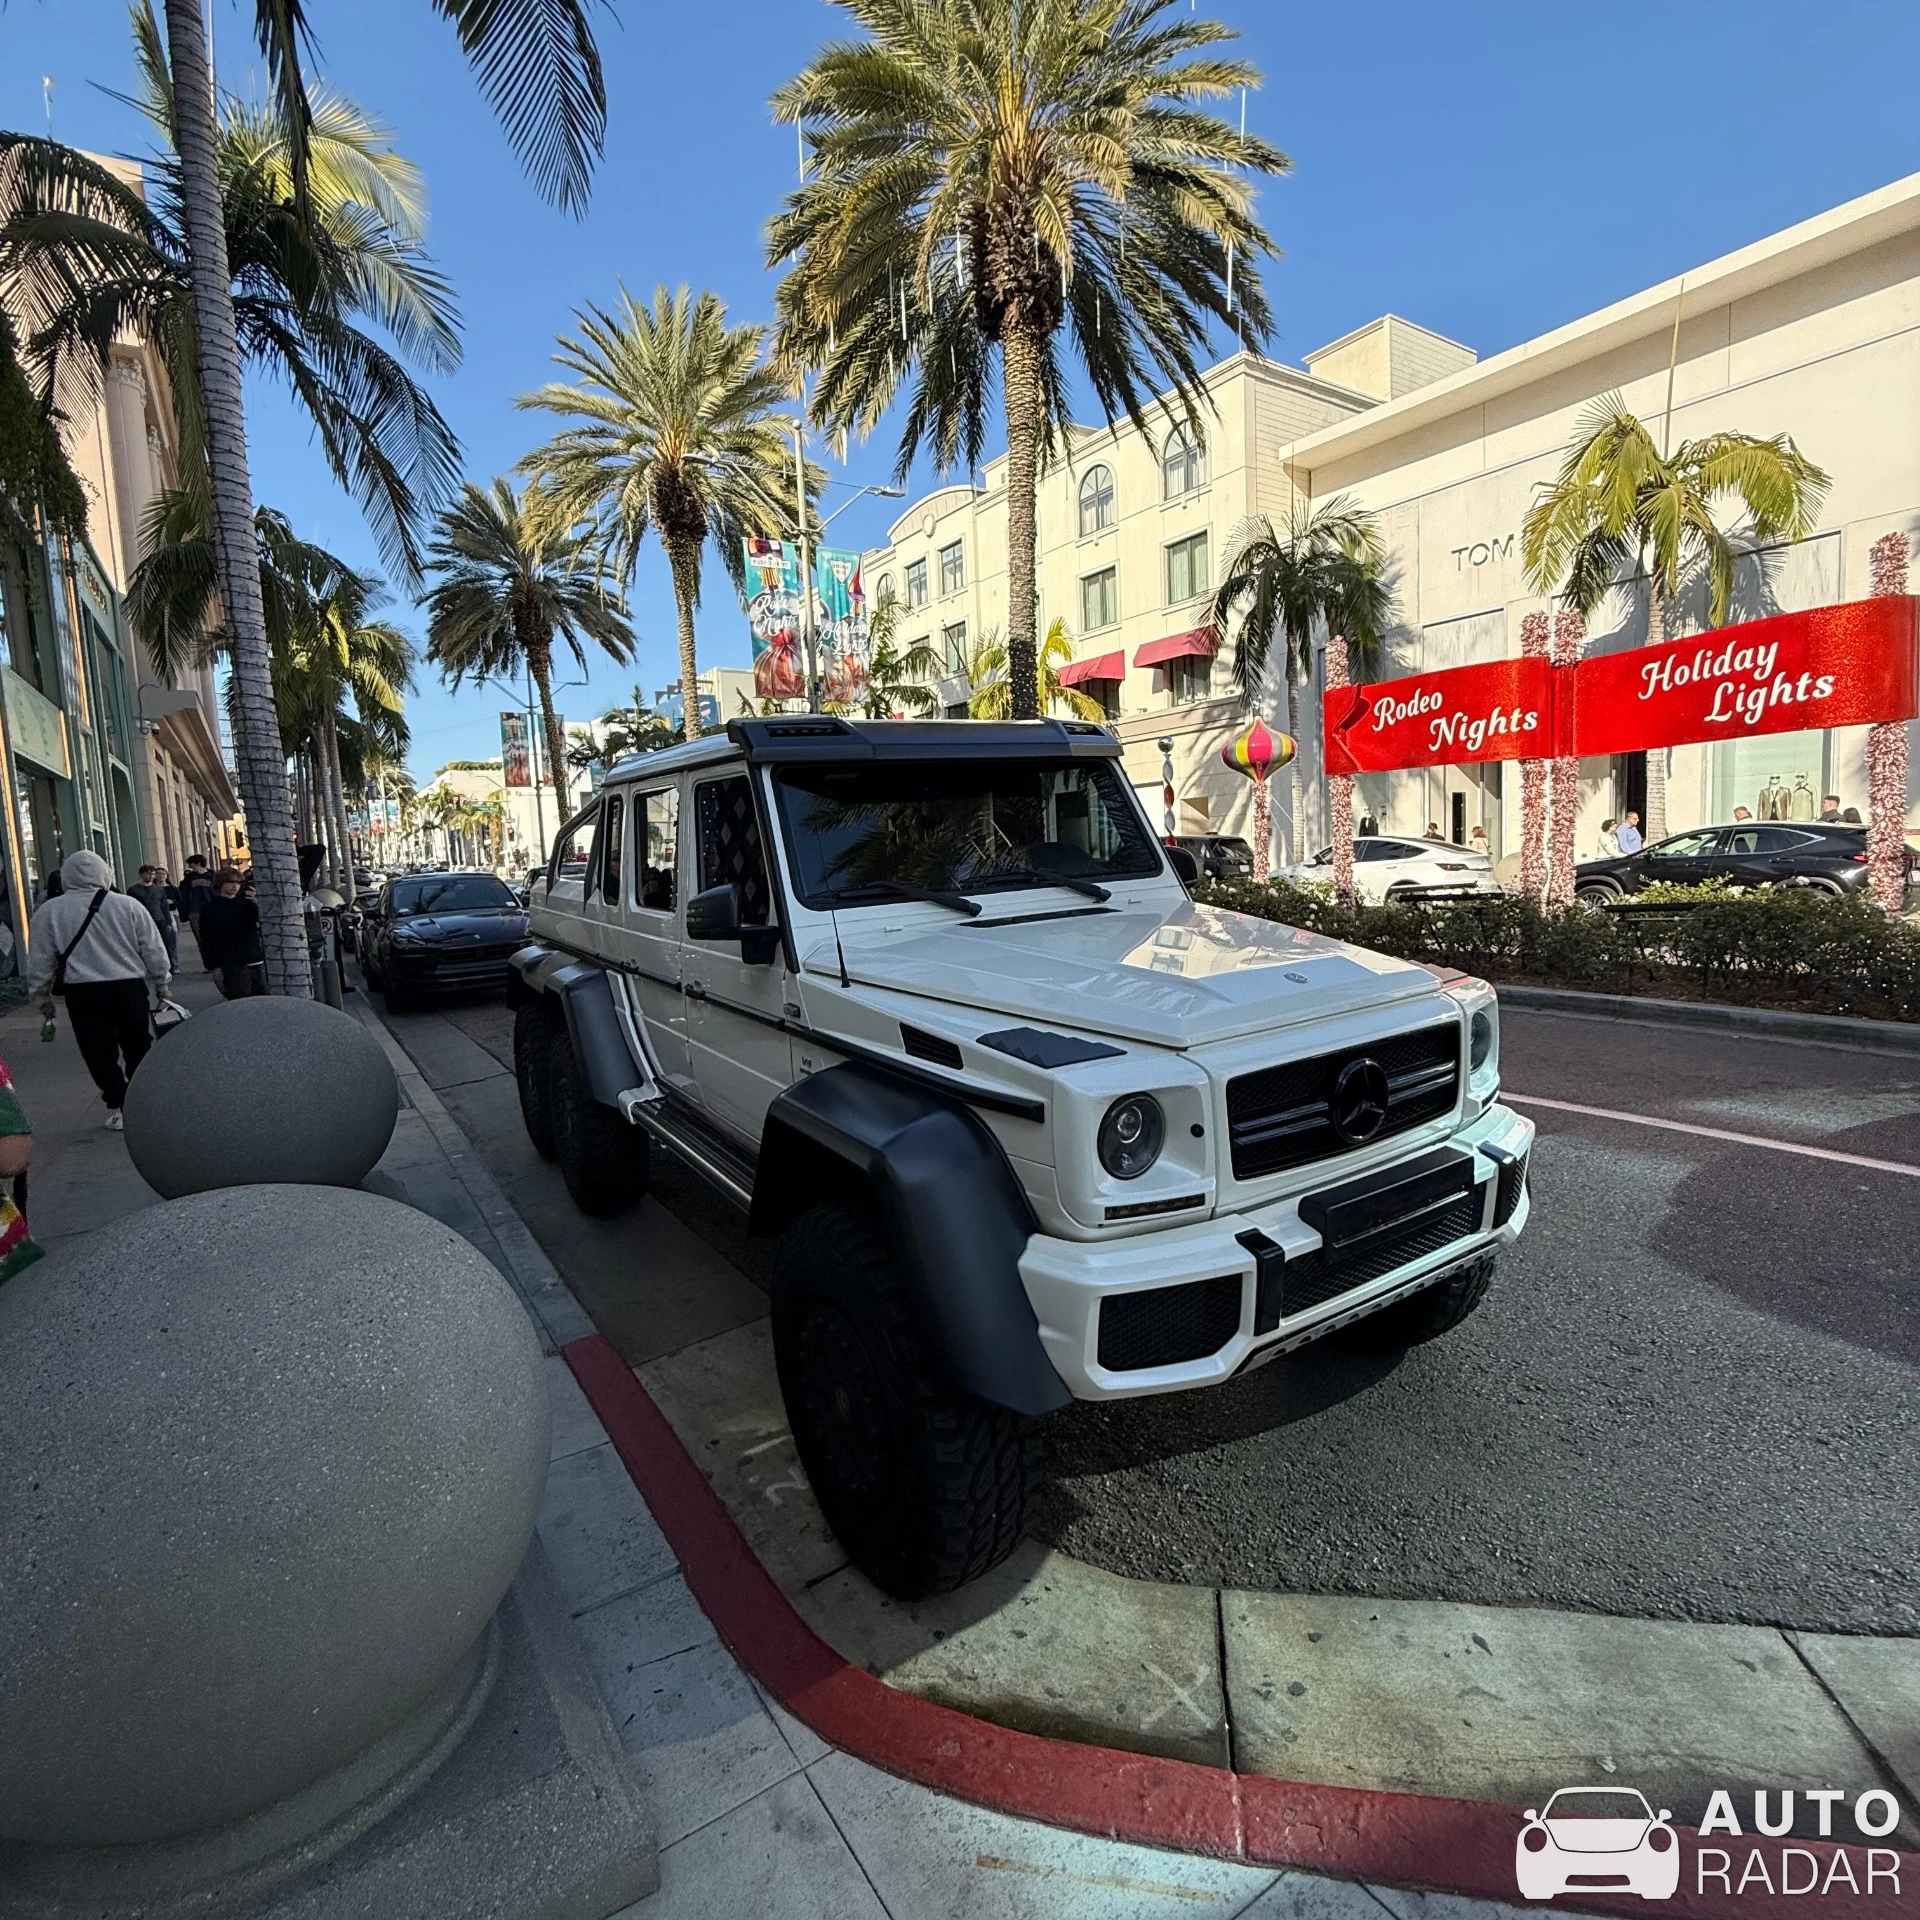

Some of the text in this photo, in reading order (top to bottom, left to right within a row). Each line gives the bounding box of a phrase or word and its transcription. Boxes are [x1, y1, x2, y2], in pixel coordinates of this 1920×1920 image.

[1450, 533, 1515, 572] TOM
[753, 614, 798, 637] Nights
[1637, 640, 1779, 701] Holiday
[1371, 687, 1443, 732] Rodeo
[1703, 671, 1835, 725] Lights
[1428, 706, 1539, 751] Nights
